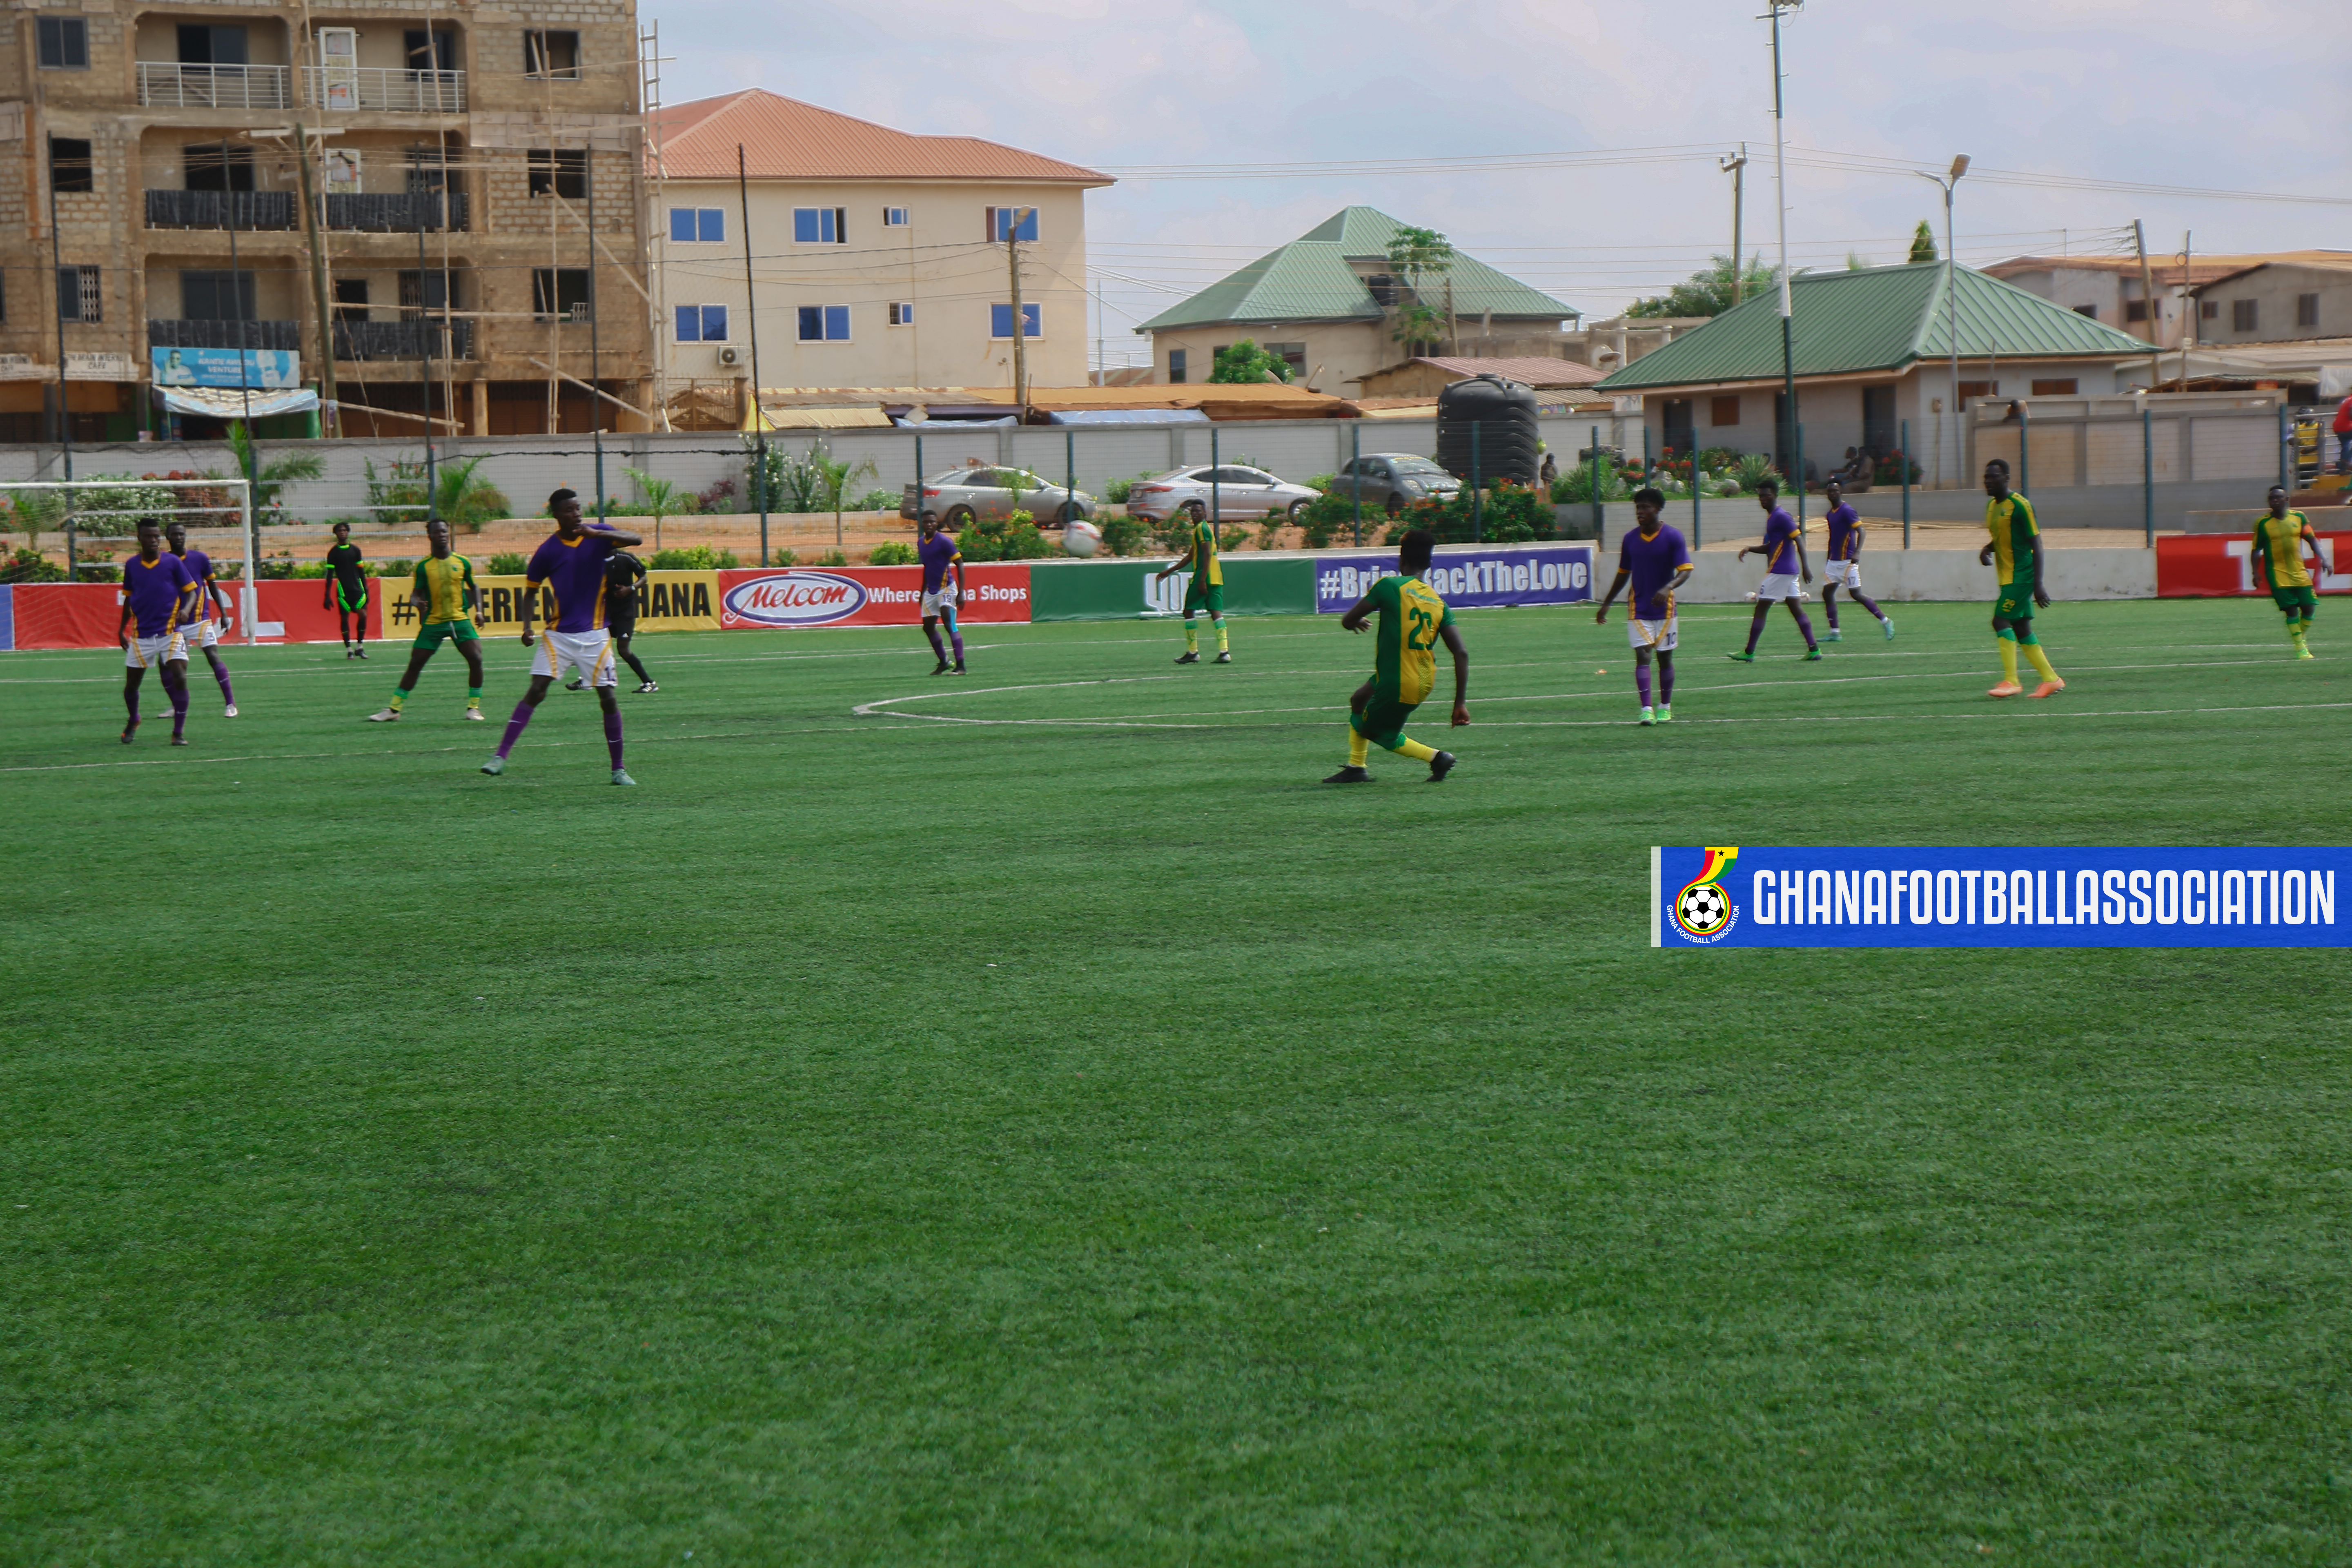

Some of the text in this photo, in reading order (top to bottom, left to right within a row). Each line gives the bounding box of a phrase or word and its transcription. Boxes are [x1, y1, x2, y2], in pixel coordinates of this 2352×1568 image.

[868, 586, 921, 603] Where
[981, 584, 1027, 603] Shops
[1320, 559, 1588, 599] #BriackTheLove
[724, 583, 850, 621] Melcom
